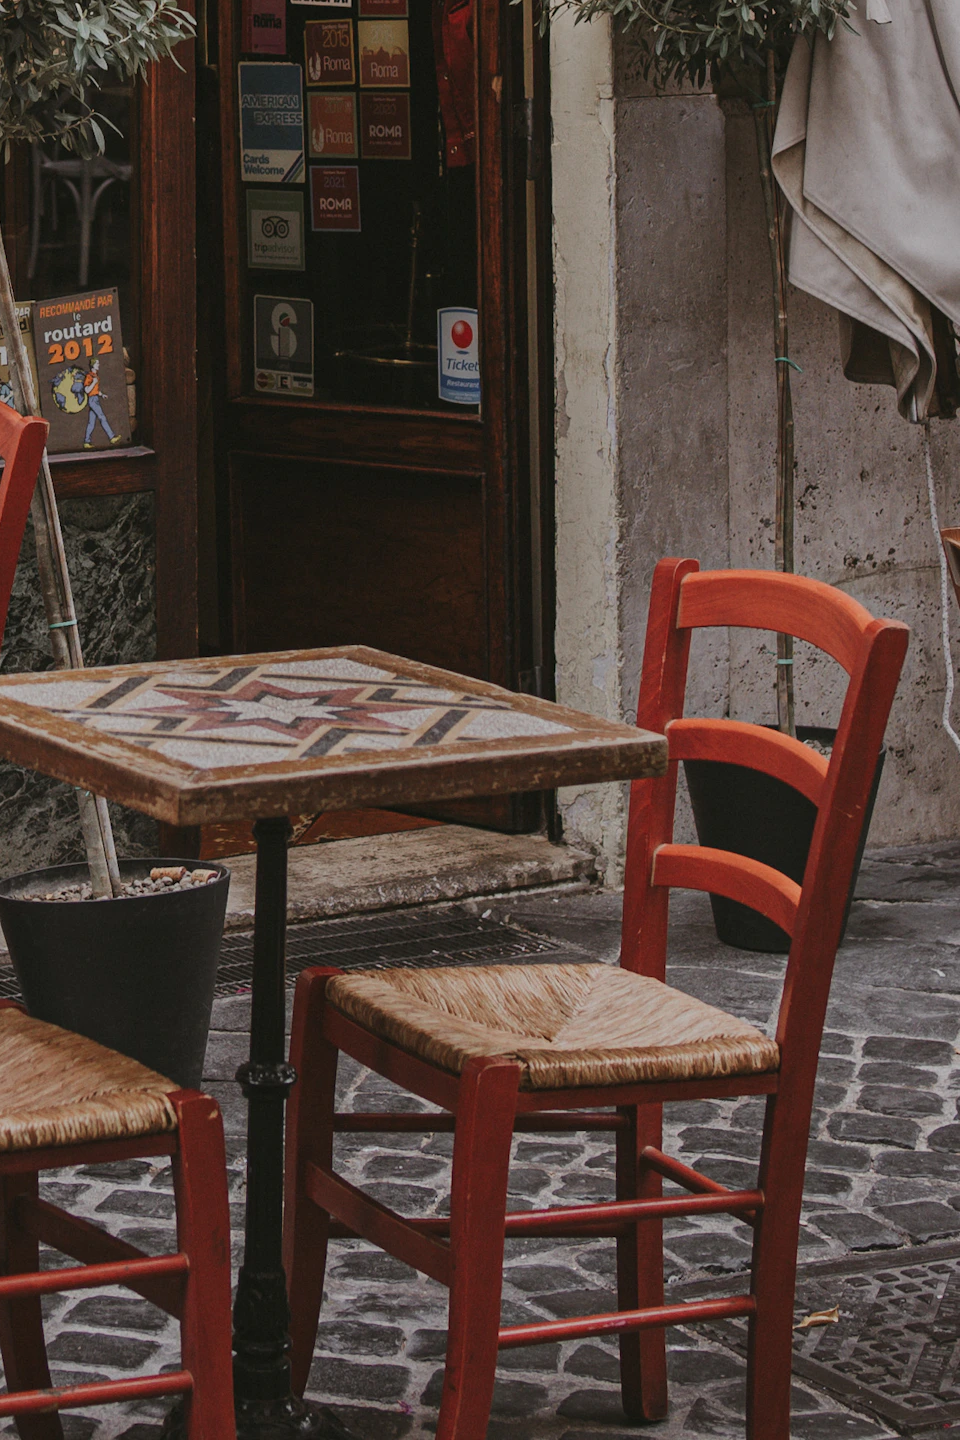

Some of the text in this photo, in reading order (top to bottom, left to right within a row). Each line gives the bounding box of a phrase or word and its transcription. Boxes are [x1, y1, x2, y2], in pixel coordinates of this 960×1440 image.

[322, 29, 350, 48] 2015
[323, 56, 351, 71] Roma
[370, 62, 399, 78] Roma
[241, 94, 300, 109] AMERICAN
[253, 110, 303, 126] EXPRESS
[325, 127, 353, 144] Roma
[369, 124, 402, 137] ROMA
[243, 153, 270, 165] Cards
[243, 164, 285, 176] Welcome
[323, 176, 346, 188] 2021
[319, 197, 352, 210] ROMA
[39, 293, 114, 318] RECOMMANDÉ PAR
[73, 312, 81, 321] le
[44, 315, 113, 344] routard
[48, 333, 114, 365] 2012
[446, 357, 479, 372] Ticket
[446, 379, 480, 389] Restaurant
